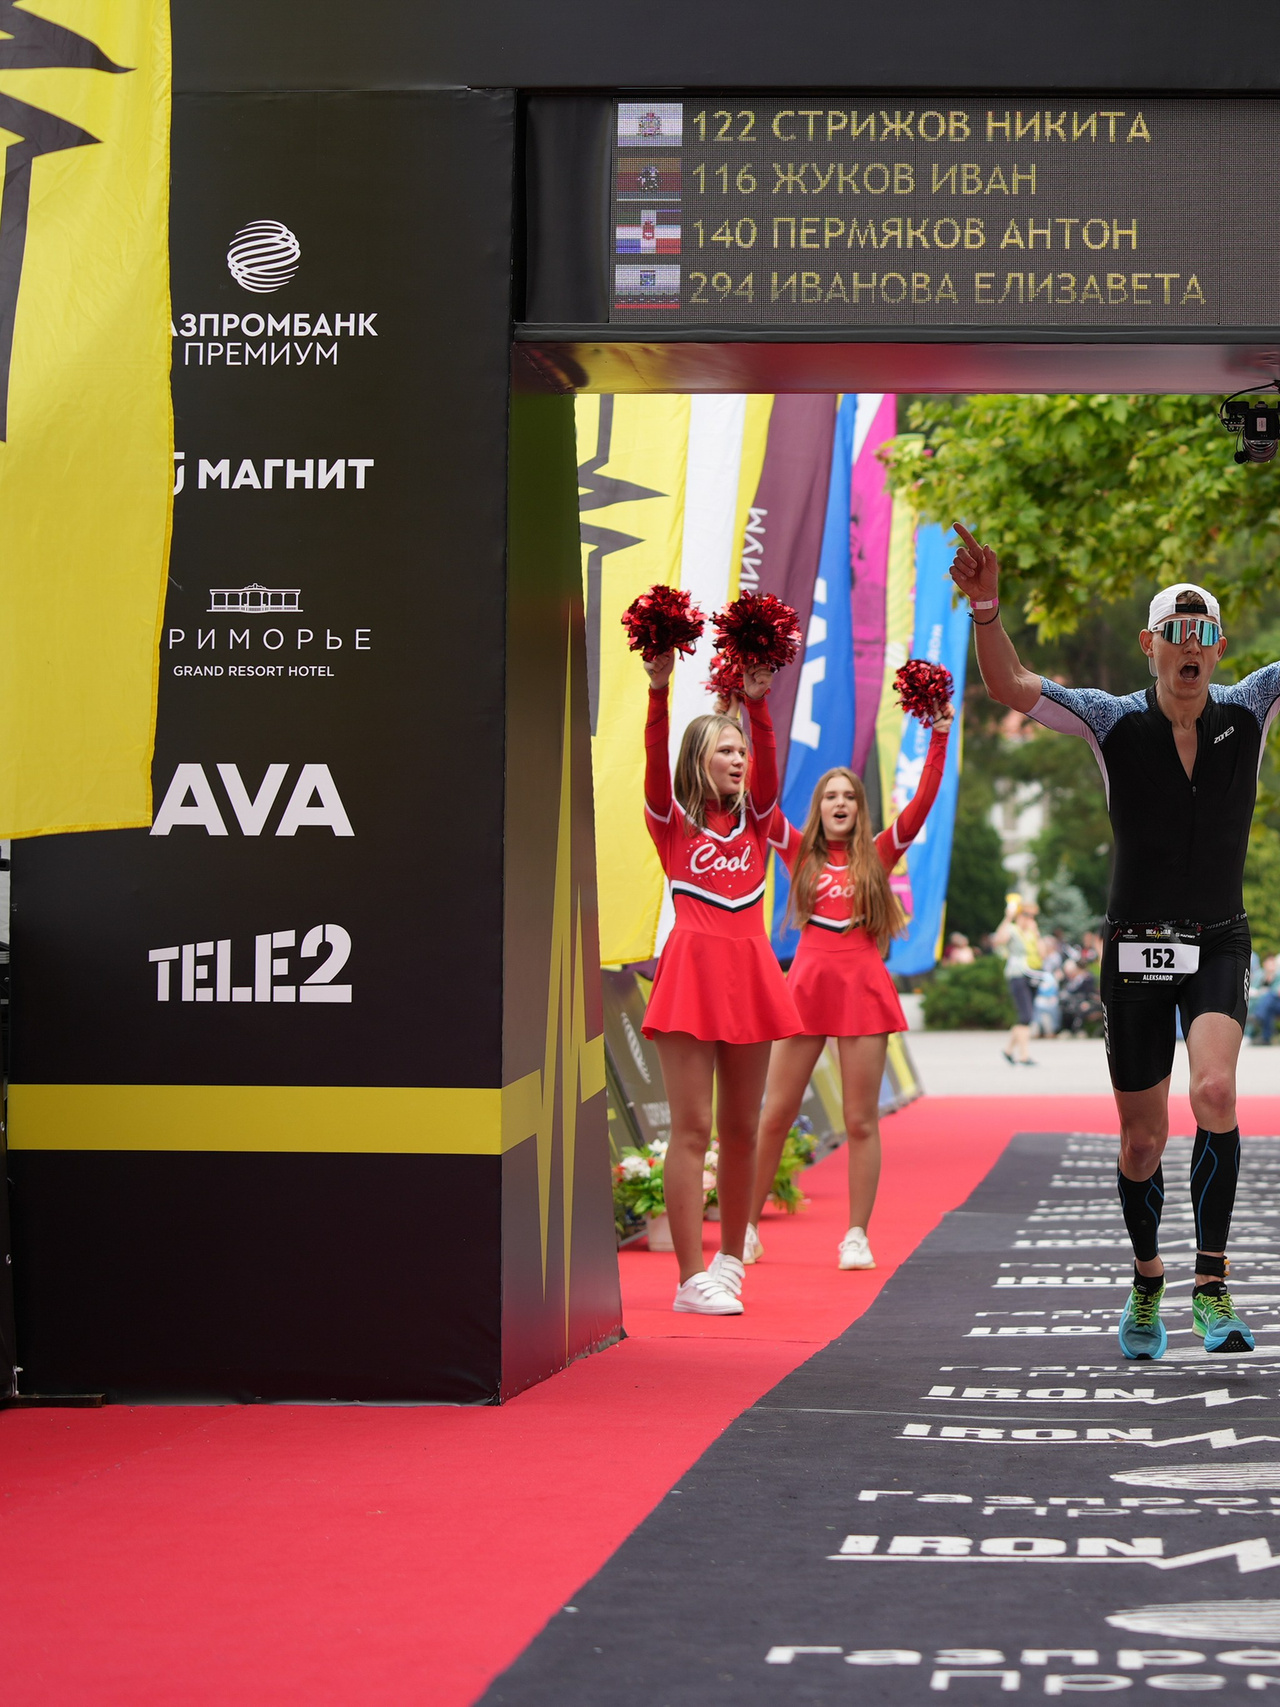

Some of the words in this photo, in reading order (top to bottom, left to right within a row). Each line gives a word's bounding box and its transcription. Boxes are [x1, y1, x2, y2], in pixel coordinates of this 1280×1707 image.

[692, 111, 757, 142] 122
[771, 110, 971, 142] СТРИЖОВ
[987, 112, 1152, 144] НИКИТА
[692, 164, 757, 195] 116
[771, 163, 915, 195] ЖУКОВ
[931, 164, 1037, 195] ИВАН
[692, 218, 757, 249] 140
[771, 217, 986, 249] ПЕРМЯКОВ
[1000, 218, 1138, 250] АНТОН
[688, 272, 755, 304] 294
[770, 272, 955, 304] ИВАНОВА
[974, 273, 1207, 305] ЕЛИЗАВЕТА
[172, 313, 379, 338] ЗПРОМБАНК
[184, 342, 338, 366] ПРЕМИУМ
[198, 458, 375, 490] МАГНИТ
[168, 629, 372, 650] РИМОРЬЕ
[173, 665, 224, 677] GRAND
[228, 665, 285, 677] RESORT
[288, 665, 335, 677] HOTEL
[148, 763, 355, 837] AVA
[690, 843, 751, 874] Cool
[148, 923, 352, 1003] TELE2
[1141, 948, 1175, 969] 152
[1142, 974, 1174, 982] ALEKSANDR
[970, 1325, 1120, 1335] IRO
[928, 1385, 1155, 1399] IRON
[902, 1423, 1153, 1440] IRON
[839, 1535, 1164, 1556] IRON
